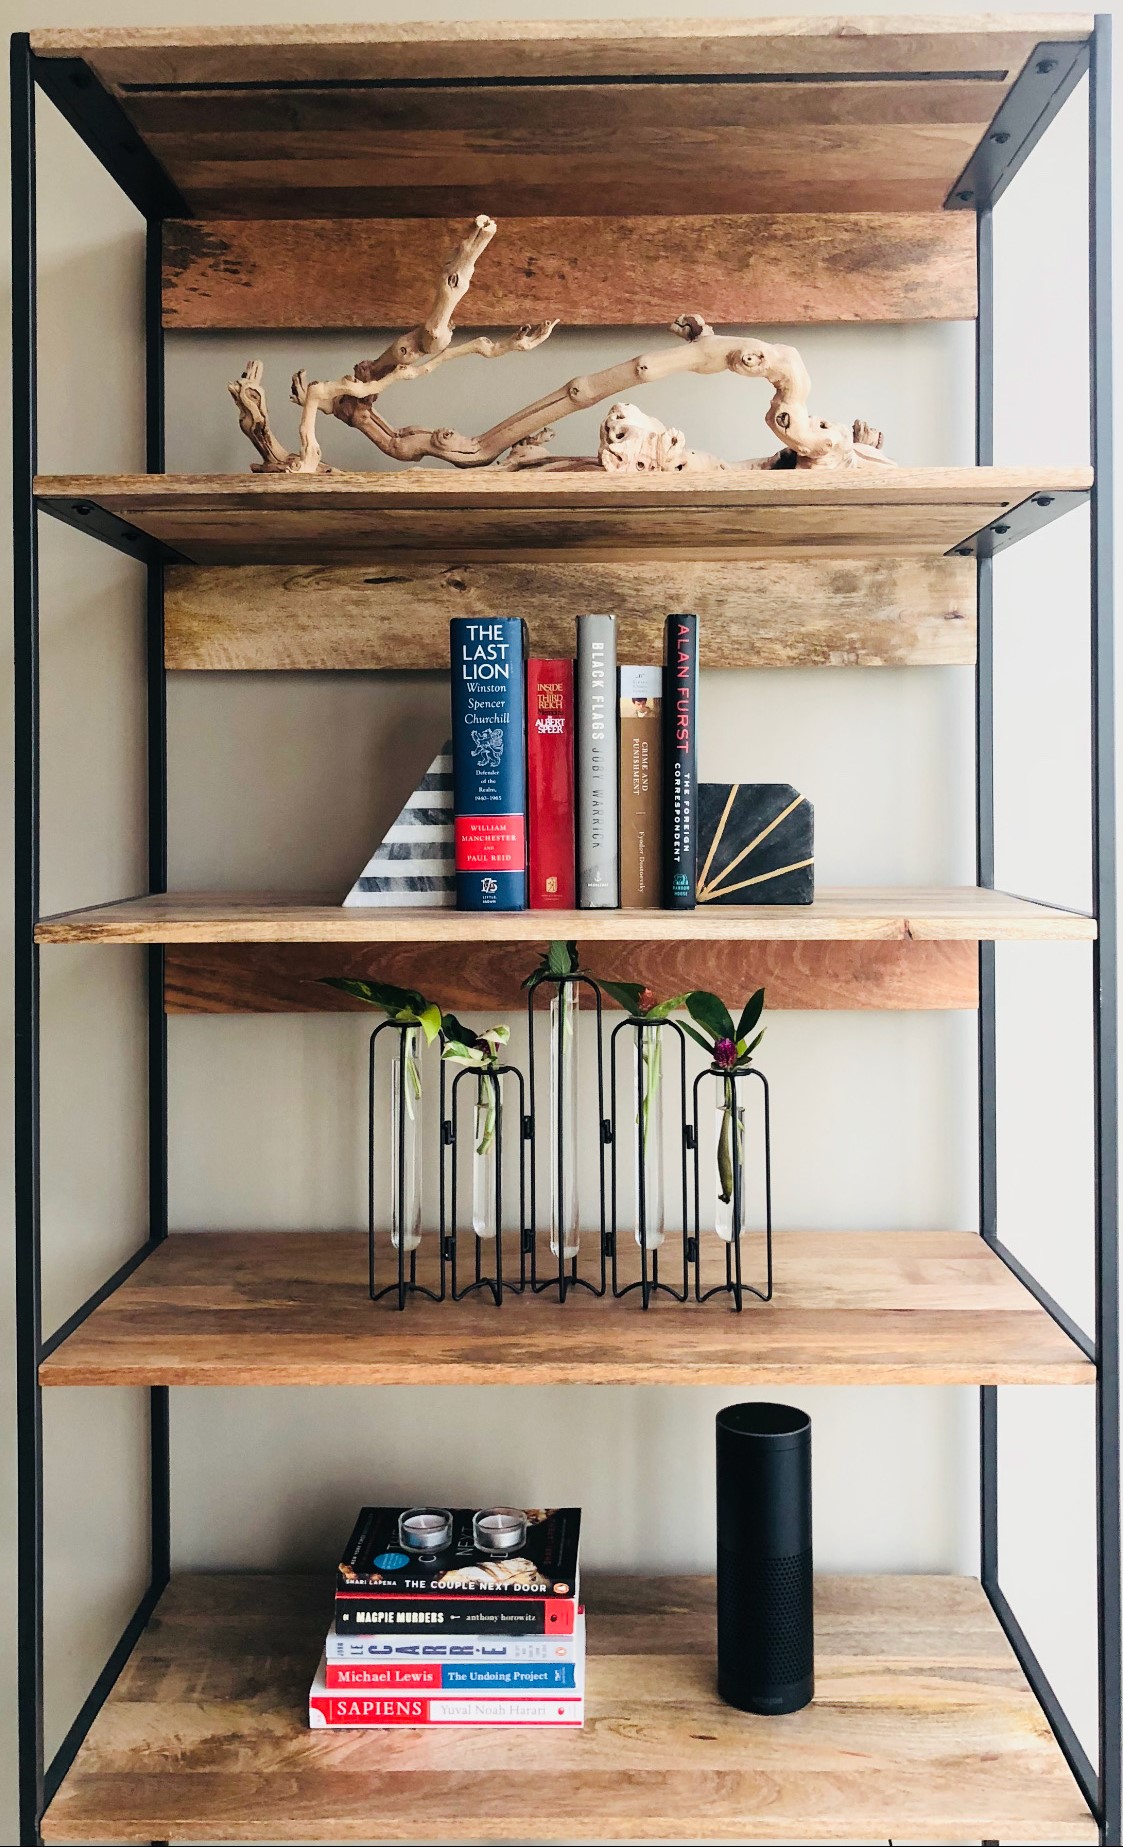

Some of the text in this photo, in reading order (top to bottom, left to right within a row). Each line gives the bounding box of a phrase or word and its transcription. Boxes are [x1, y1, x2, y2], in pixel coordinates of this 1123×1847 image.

[466, 625, 504, 641] THE
[463, 644, 510, 660] LAST
[591, 642, 605, 688] BLACK
[463, 664, 509, 680] LION
[467, 683, 507, 693] Winston
[537, 683, 564, 691] INSIDE
[676, 624, 690, 754] ALAN FURST
[467, 698, 506, 710] Spencer
[537, 694, 564, 703] THIRD
[538, 701, 563, 709] REICH
[464, 713, 510, 725] Churchill
[535, 718, 566, 727] ALBERT
[591, 695, 605, 741] FLAGS
[537, 726, 564, 734] SPEER
[633, 738, 641, 796] PUNISHMENT
[641, 741, 650, 792] CRIME AND
[673, 762, 682, 863] CORRESPONDENT
[683, 772, 691, 852] THE FOREIGN
[591, 789, 604, 849] WARRICK
[638, 831, 646, 855] Fyodor
[405, 1580, 547, 1593] THE COUPLE NEXT DOOR
[356, 1612, 445, 1624] MAGPIE MURDERS
[465, 1613, 537, 1623] anthony horowitz
[338, 1670, 433, 1682] Michael Lewis
[448, 1672, 467, 1681] The
[470, 1671, 511, 1683] Undoing
[513, 1671, 548, 1682] Project
[337, 1701, 422, 1716] SAPIENS
[441, 1704, 547, 1715] Yuval Noah Harari
